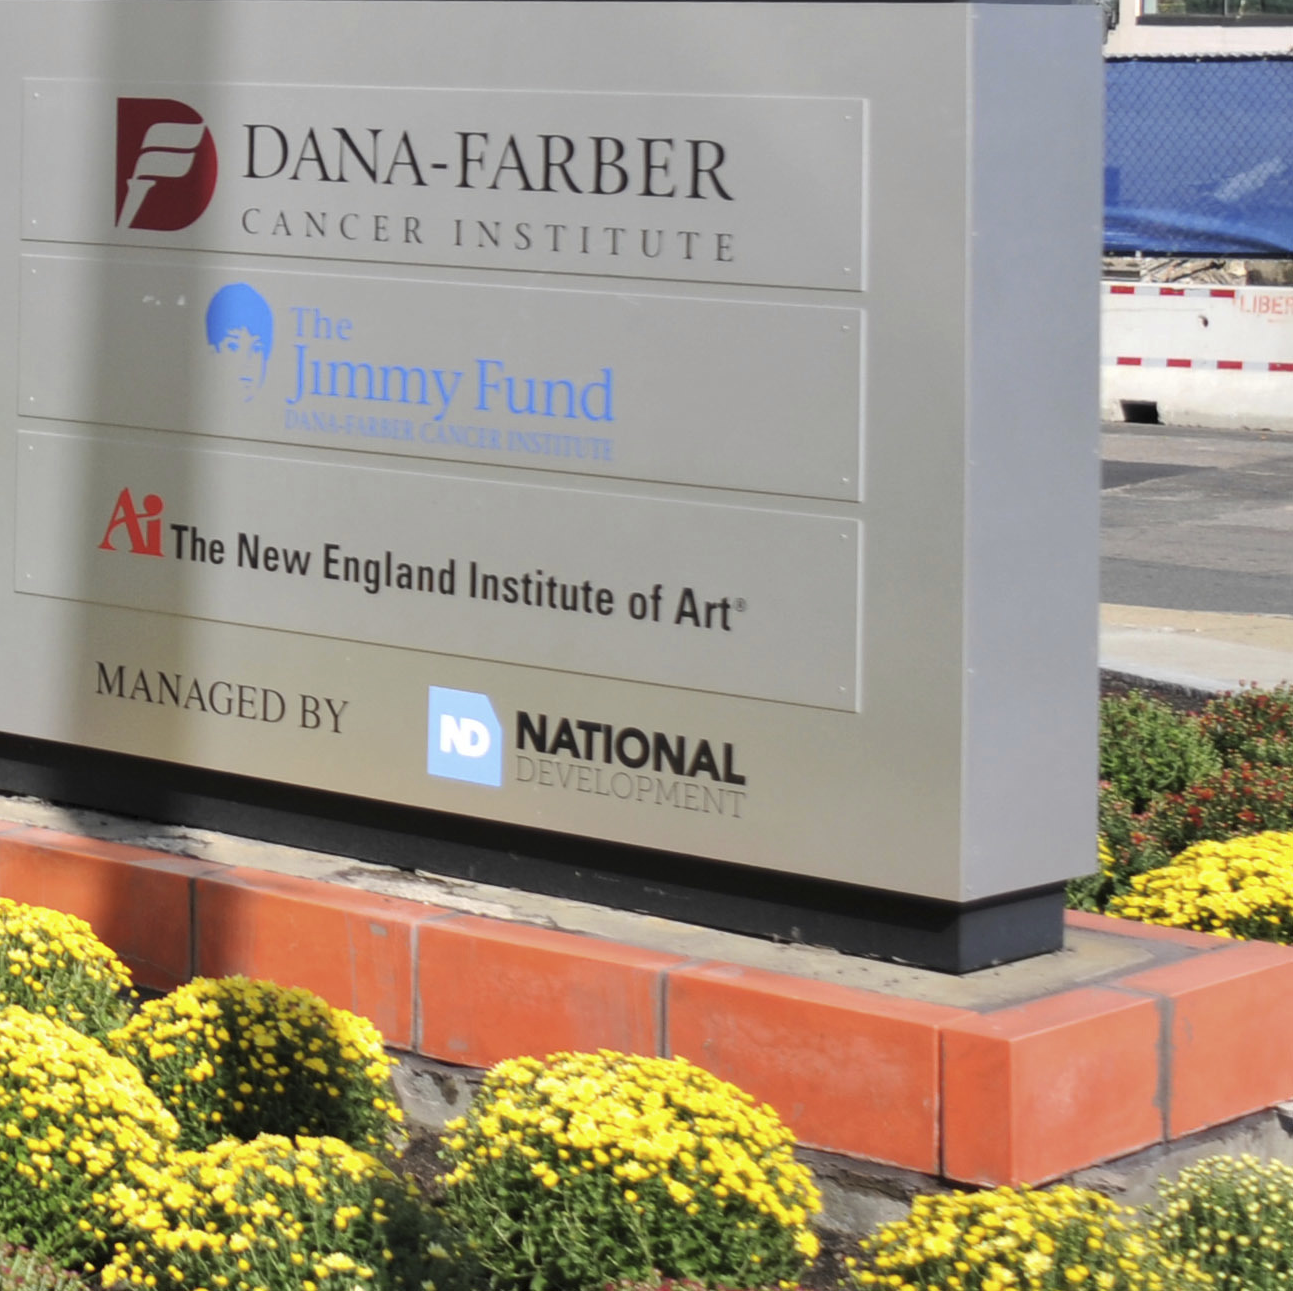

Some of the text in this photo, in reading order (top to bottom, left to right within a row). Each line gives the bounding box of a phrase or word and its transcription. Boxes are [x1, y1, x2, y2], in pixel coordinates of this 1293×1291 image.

[242, 123, 735, 202] DANA-FARBER
[241, 207, 735, 263] CANCER INSTITUTE
[289, 305, 354, 341] The
[285, 342, 616, 423] Jimmy Fund
[284, 408, 615, 461] DANA-FARBER CANCER INSTITUTE
[97, 487, 166, 557] Ai
[169, 523, 226, 565] The
[236, 532, 312, 576] New
[322, 543, 456, 595] England
[469, 561, 615, 617] Institute
[628, 583, 664, 623] of
[95, 660, 350, 735] MANAGED BY
[439, 712, 492, 758] ND
[515, 709, 748, 787] NATIONAL
[515, 753, 748, 819] DEVELOPMENT
